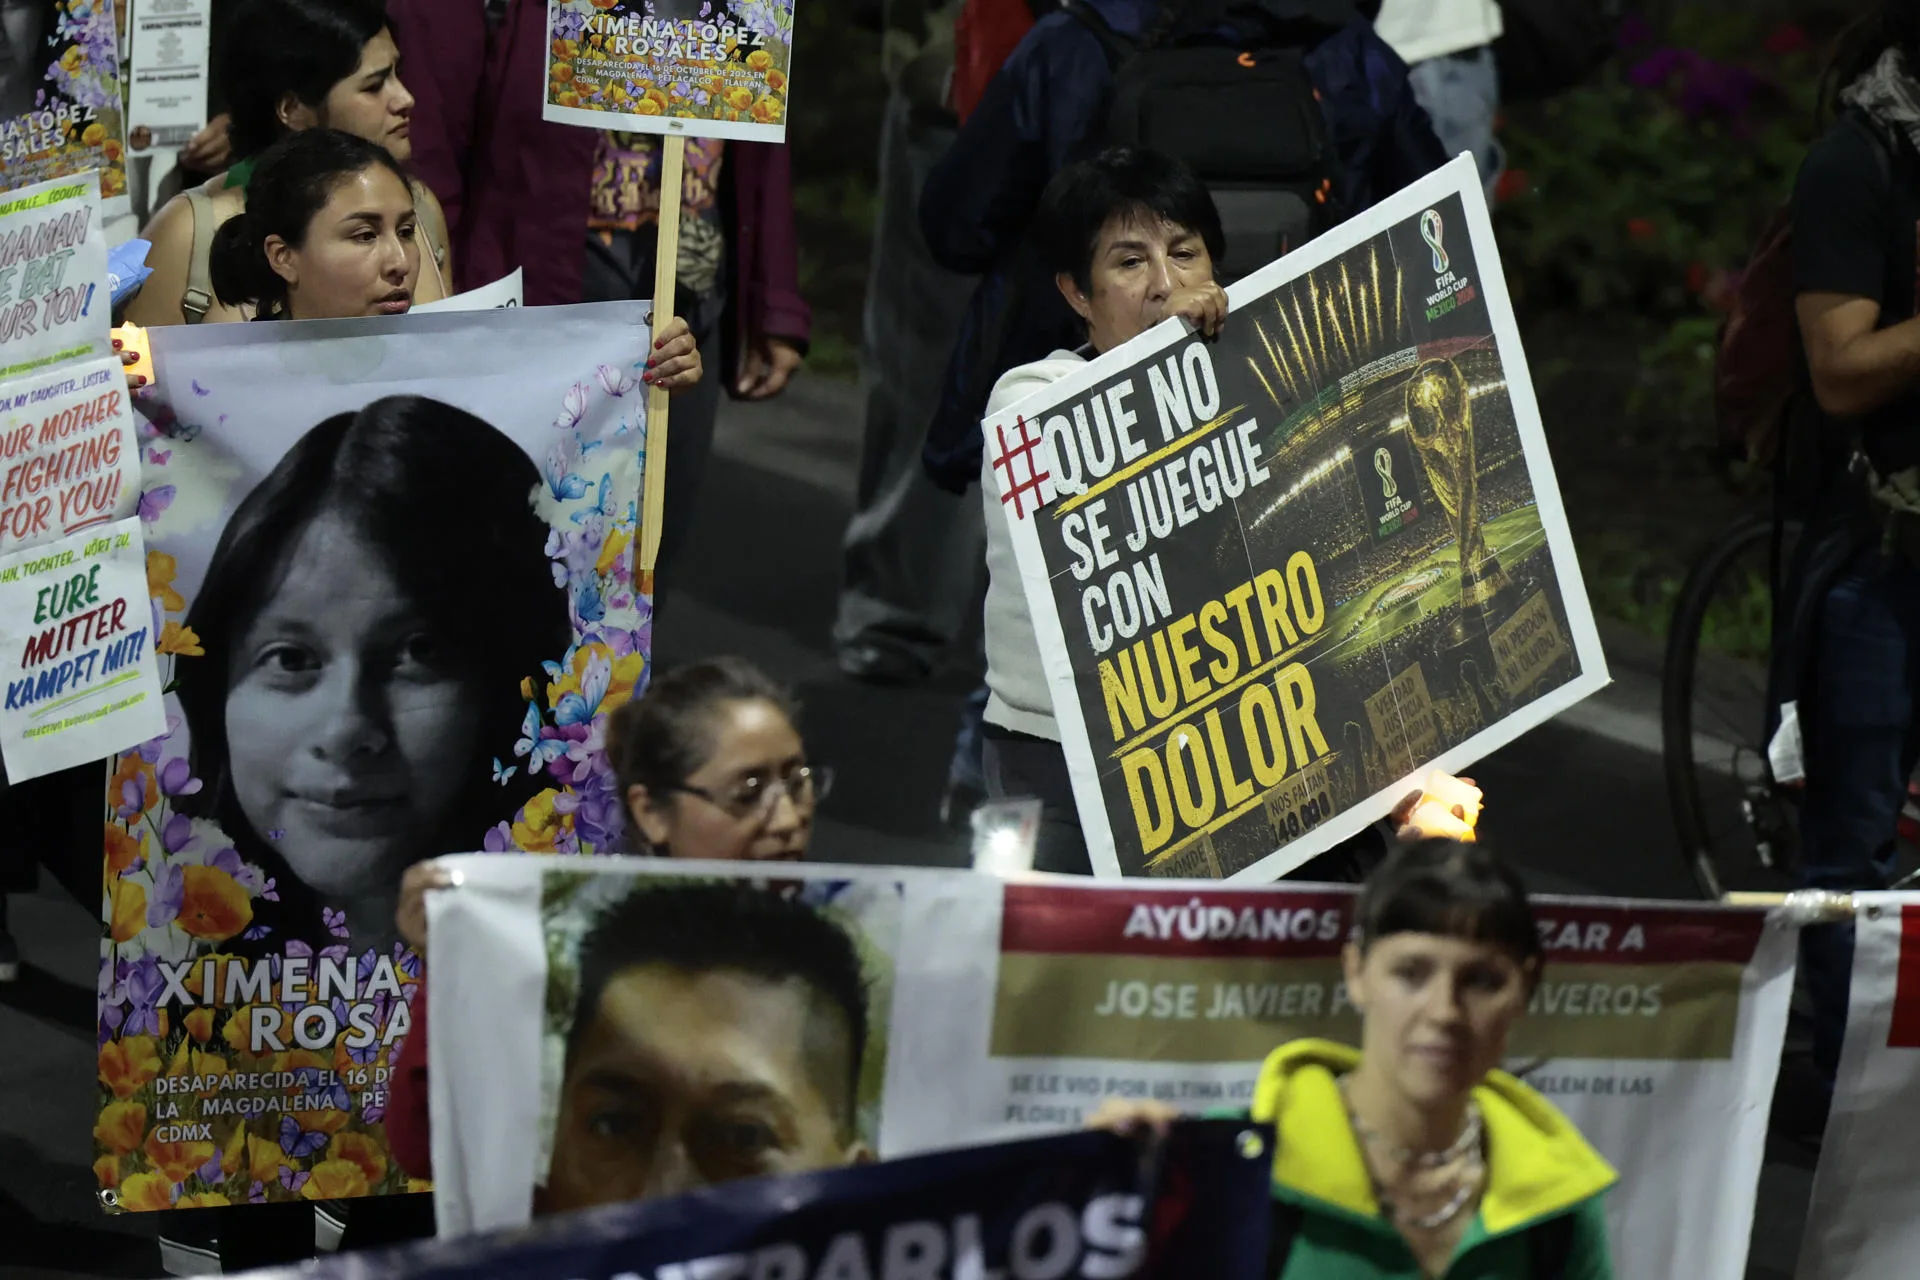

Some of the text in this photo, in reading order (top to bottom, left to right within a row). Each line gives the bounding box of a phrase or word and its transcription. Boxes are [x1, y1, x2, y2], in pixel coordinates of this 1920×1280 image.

[579, 15, 767, 46] XIMENA LÓPEZ
[615, 36, 729, 62] ROSALES
[575, 75, 600, 85] CDMX
[576, 57, 638, 70] DESAPARECIDA
[641, 63, 650, 71] EL
[652, 64, 661, 72] 16
[676, 65, 715, 76] OCTUBRE
[716, 69, 727, 77] DE
[754, 71, 765, 79] EN
[576, 67, 587, 75] LA
[595, 69, 649, 80] MAGDALENA
[28, 105, 98, 134] LÓPEZ
[19, 249, 75, 300] BAT
[1426, 277, 1468, 306] WORLD CUP
[1435, 271, 1456, 290] FIFA
[1147, 341, 1220, 443] NO
[38, 390, 121, 445] MOTHER
[2, 428, 122, 503] FIGHTING
[0, 469, 122, 539] FOR YOU!
[1062, 417, 1271, 581] SE JUEGUE
[1385, 495, 1402, 511] FIFA
[33, 563, 101, 625] EURE
[1081, 553, 1173, 654] CON
[21, 597, 127, 669] MUTTER
[101, 626, 147, 676] MIT!
[1098, 550, 1325, 742] NUESTRO
[1375, 676, 1416, 715] VERDAD
[1120, 662, 1330, 855] DOLOR
[1271, 795, 1291, 815] NOS
[1123, 897, 1342, 942] AYÚDANOS
[1617, 923, 1646, 952] A
[155, 954, 402, 1009] XIMENA
[1094, 979, 1199, 1019] JOSE
[1204, 981, 1324, 1019] JAVIER
[156, 1070, 310, 1094] DESAPARECIDA
[318, 1069, 338, 1086] EL
[347, 1067, 369, 1085] 16
[1591, 1076, 1614, 1094] DE
[1620, 1076, 1654, 1095] LAS
[156, 1095, 336, 1119] LA MAGDALENA
[156, 1123, 212, 1143] CDMX
